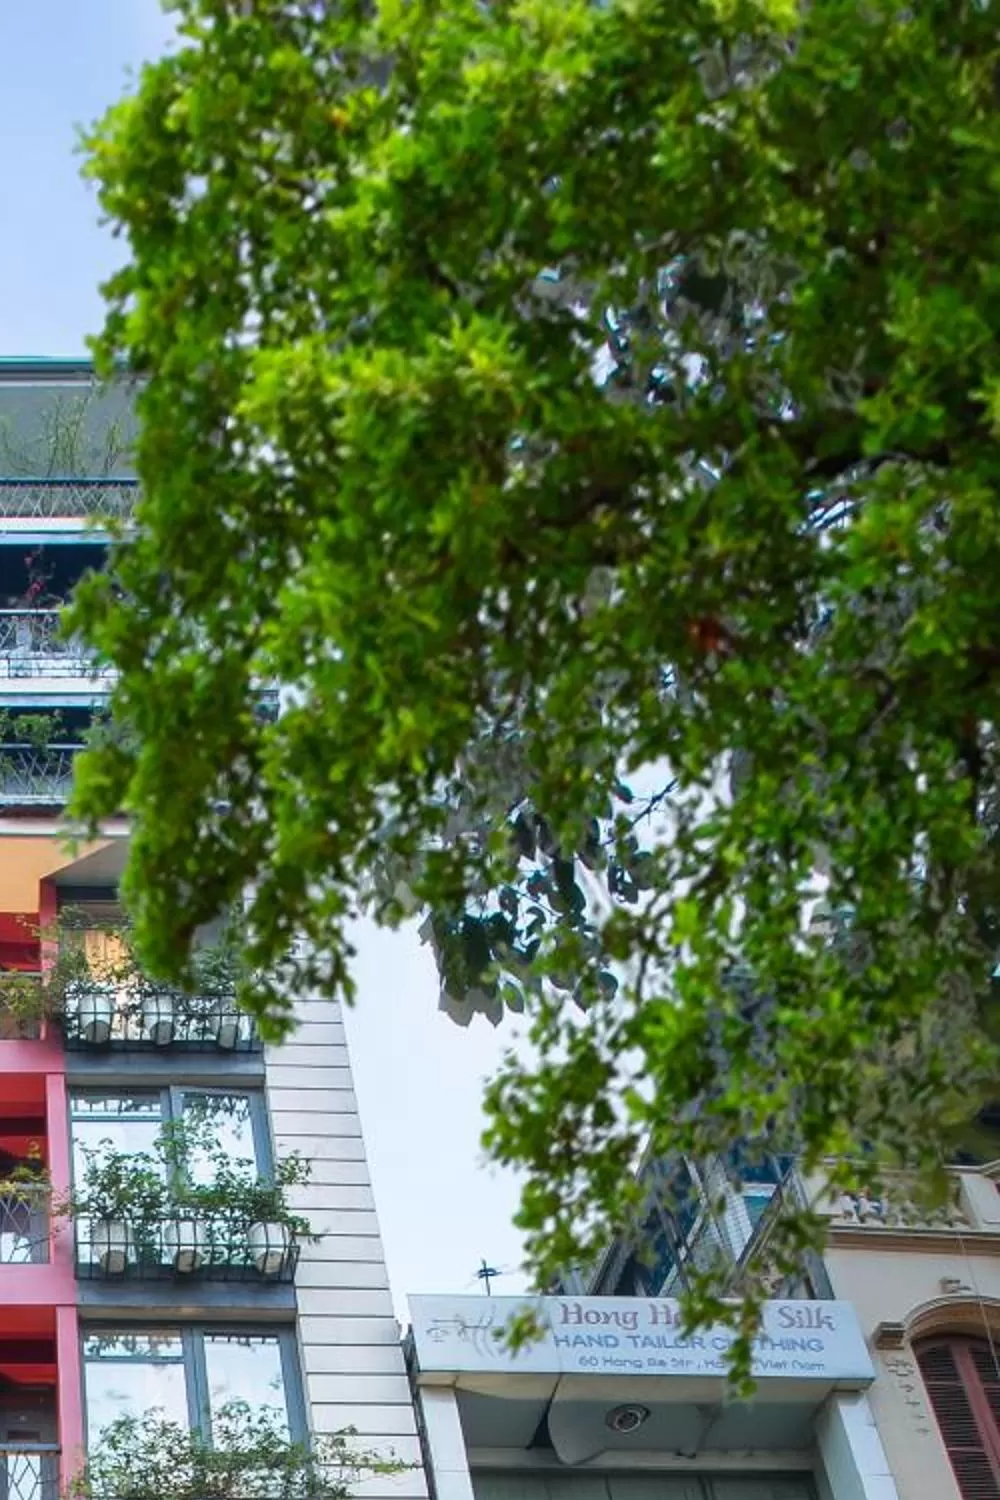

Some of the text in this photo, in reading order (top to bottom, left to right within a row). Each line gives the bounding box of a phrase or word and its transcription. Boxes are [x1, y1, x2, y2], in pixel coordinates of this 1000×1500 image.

[560, 1303, 639, 1330] Hong
[777, 1305, 836, 1331] Silk
[554, 1334, 619, 1349] HAND
